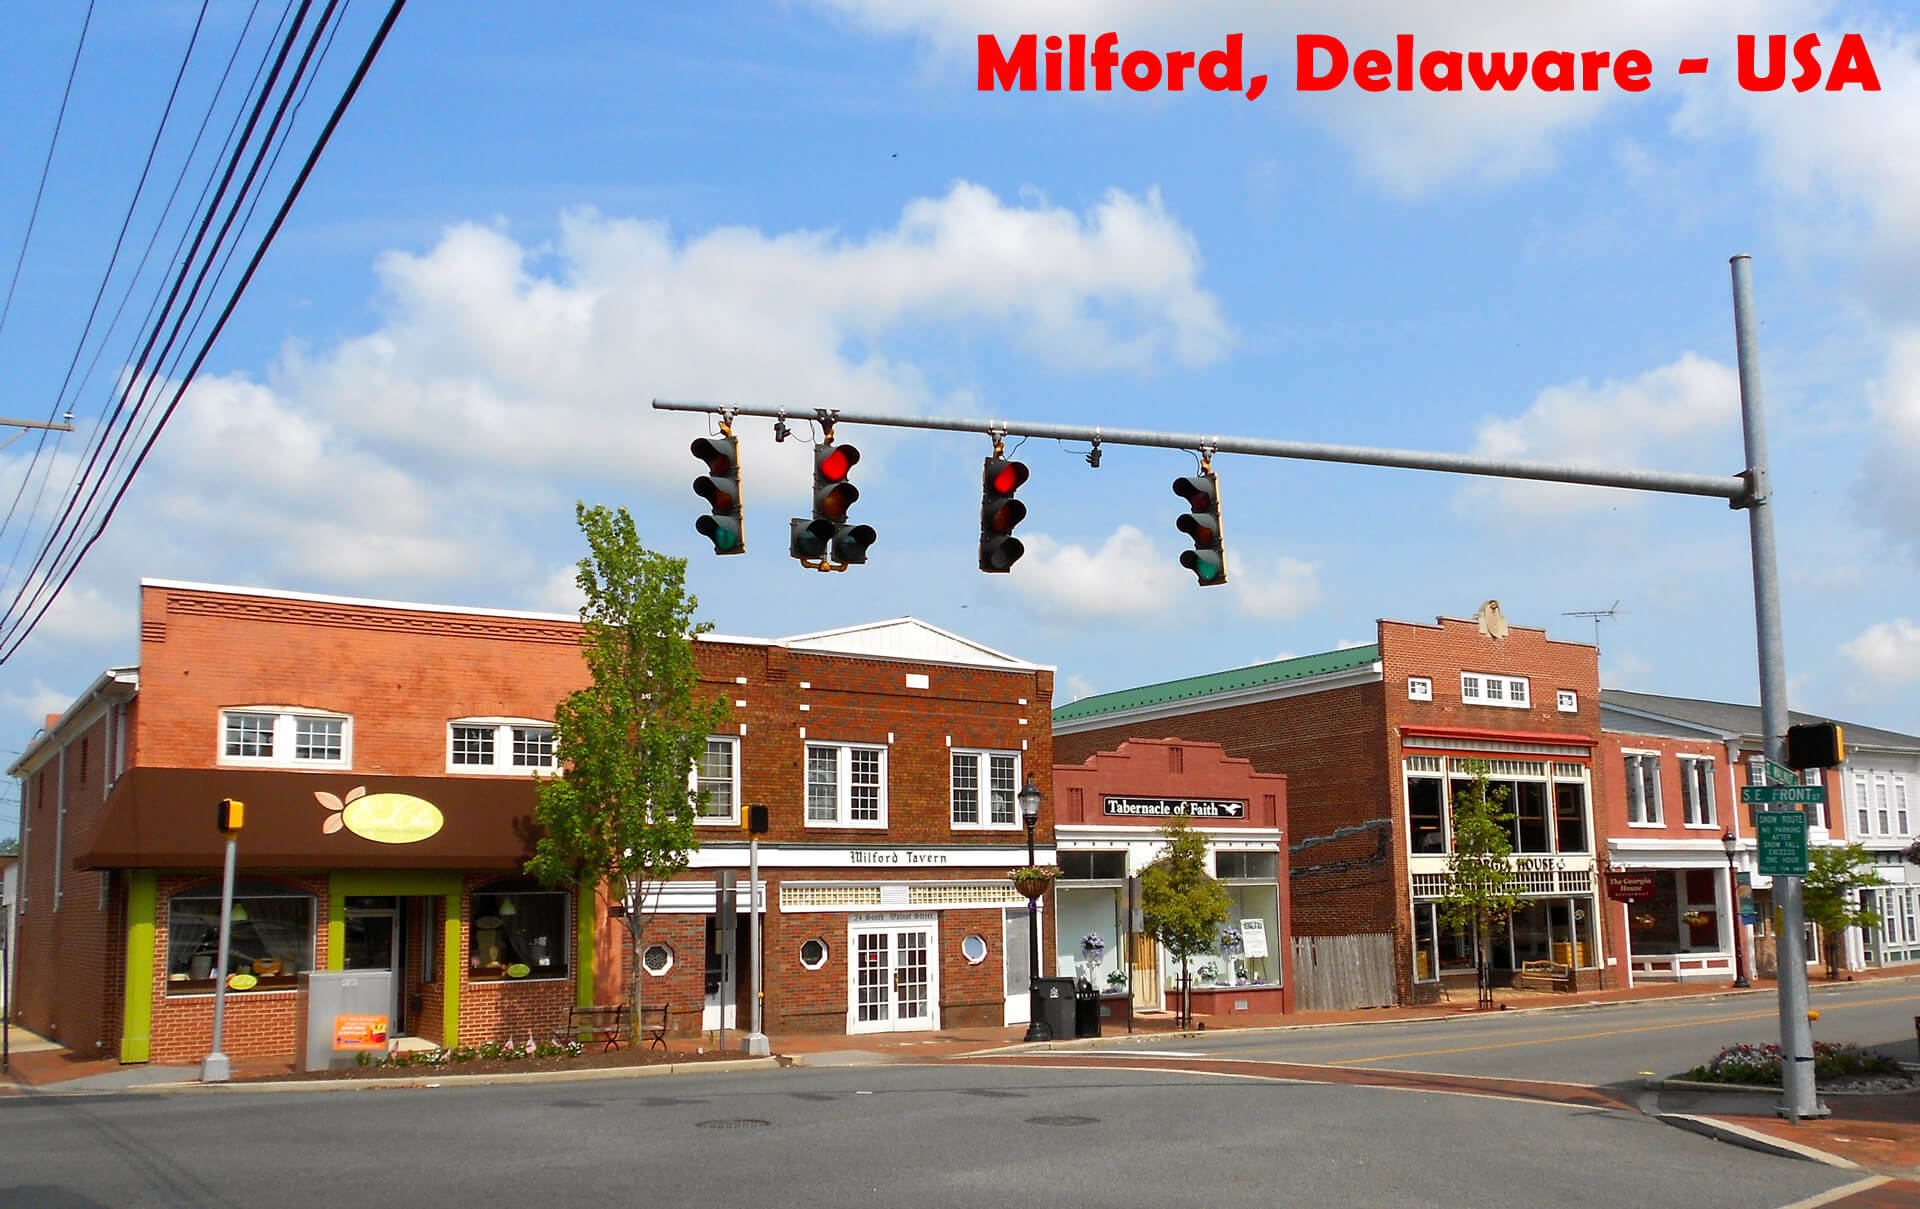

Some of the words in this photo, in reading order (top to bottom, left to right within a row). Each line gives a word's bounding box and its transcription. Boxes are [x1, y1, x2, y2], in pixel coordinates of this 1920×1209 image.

[1772, 788, 1812, 801] FRONT
[1108, 799, 1170, 815] Tabernacle
[1173, 801, 1188, 815] of
[1190, 802, 1218, 816] Faith
[850, 850, 898, 863] Milford
[906, 851, 947, 863] Tavern
[1516, 857, 1554, 871] HOUSE
